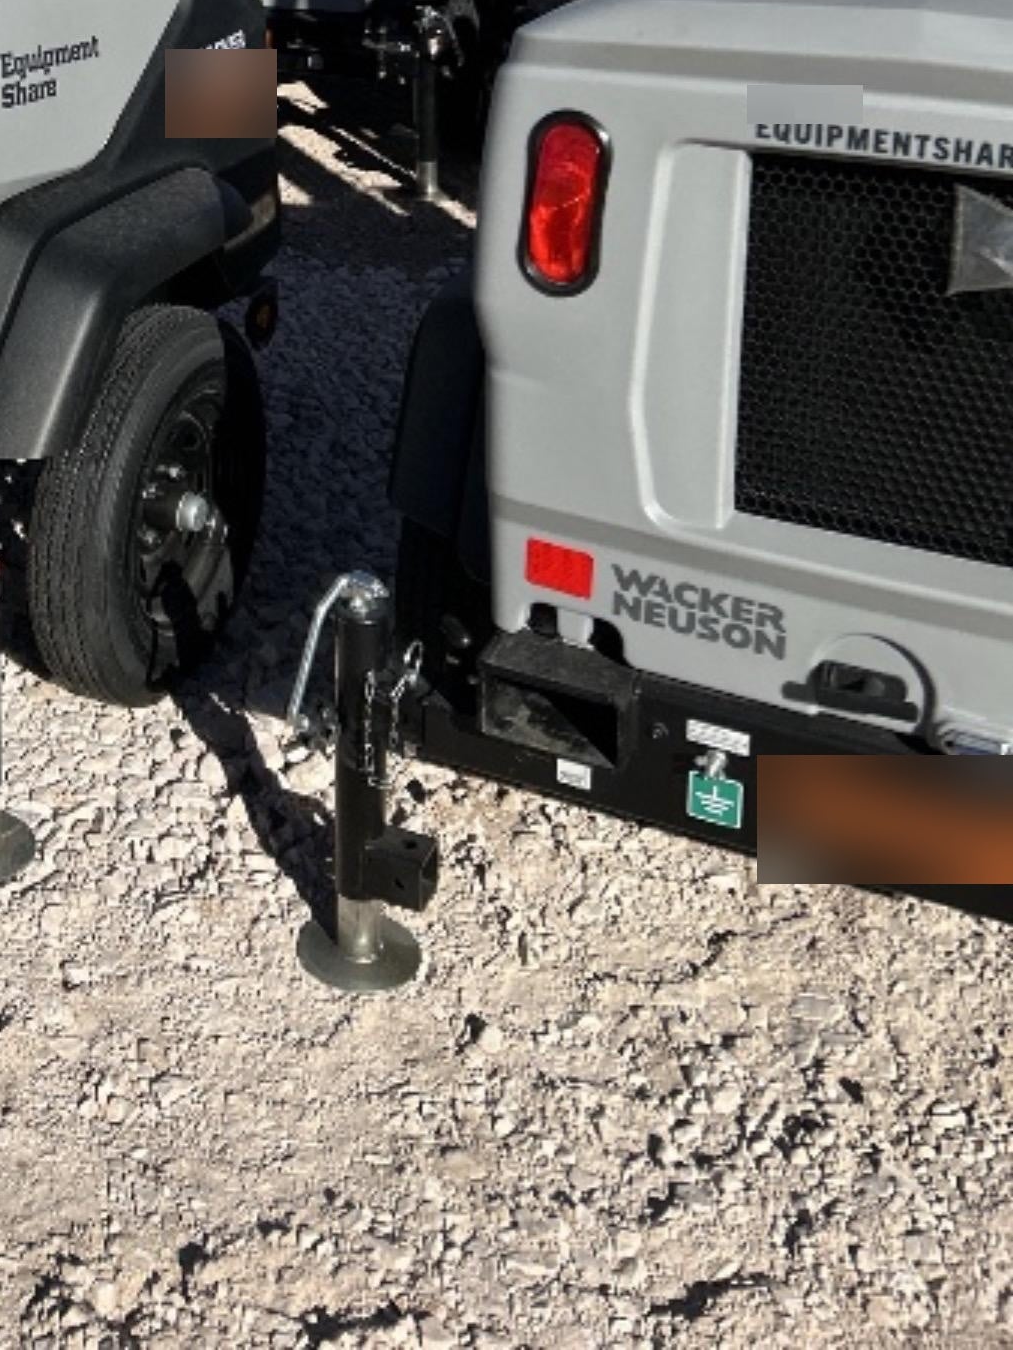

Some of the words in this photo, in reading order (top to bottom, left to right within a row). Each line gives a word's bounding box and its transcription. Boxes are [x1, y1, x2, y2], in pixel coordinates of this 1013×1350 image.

[0, 35, 99, 80] Equipment
[1, 78, 57, 108] Share
[610, 563, 787, 634] WACKER
[612, 591, 787, 661] NEUSON
